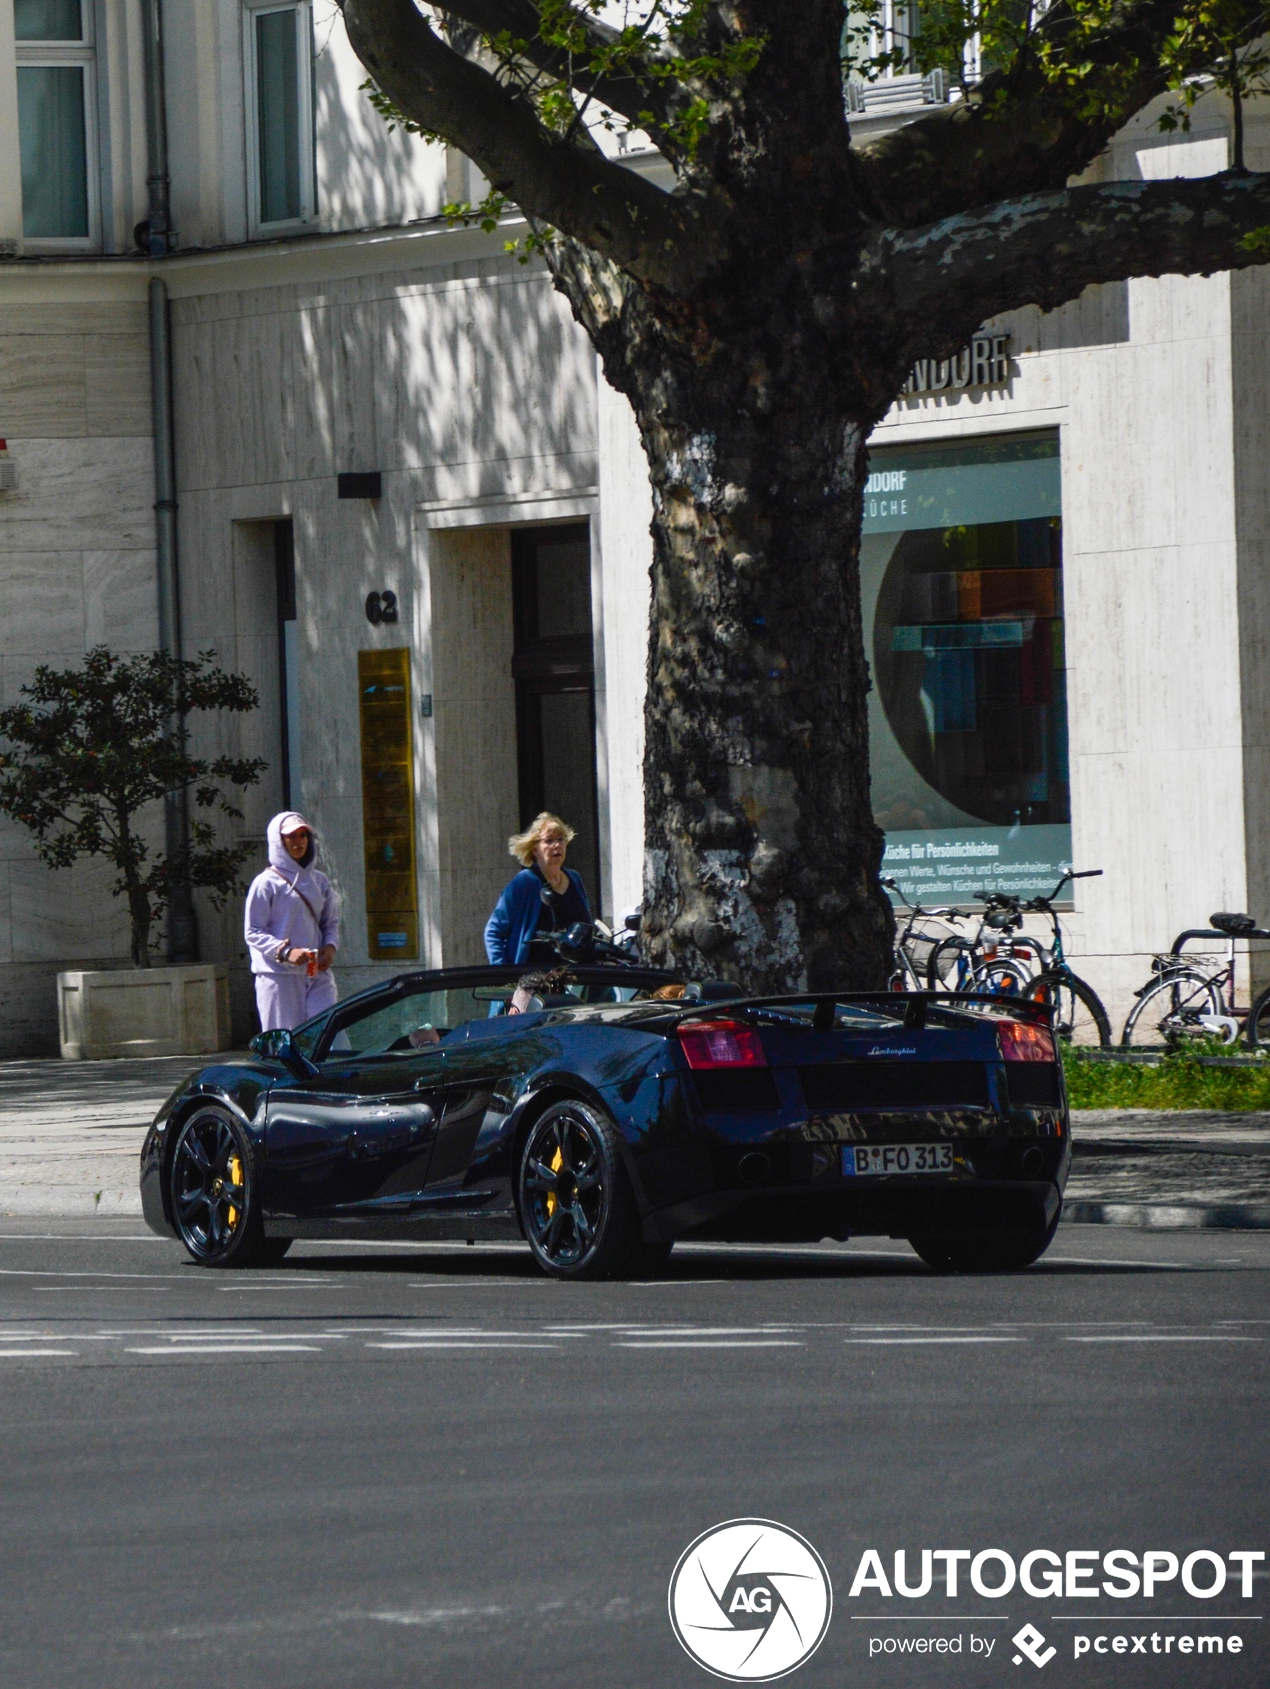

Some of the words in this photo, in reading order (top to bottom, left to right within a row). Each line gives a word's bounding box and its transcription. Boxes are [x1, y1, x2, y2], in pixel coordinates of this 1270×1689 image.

[863, 499, 908, 518] ÜCHE
[365, 590, 398, 625] 62
[912, 843, 925, 858] für
[927, 842, 999, 858] Persönlichkeiten
[909, 866, 935, 878] Werte,
[937, 864, 975, 876] Wünsche
[976, 863, 991, 874] und
[993, 861, 1051, 874] Gewohnheiten
[900, 882, 915, 893] Wir
[916, 880, 952, 895] gestalten
[953, 879, 982, 891] Küchen
[984, 878, 996, 890] für
[868, 1046, 916, 1056] Lamborghini
[856, 1149, 869, 1172] B
[883, 1147, 910, 1171] FO
[915, 1146, 952, 1169] 313
